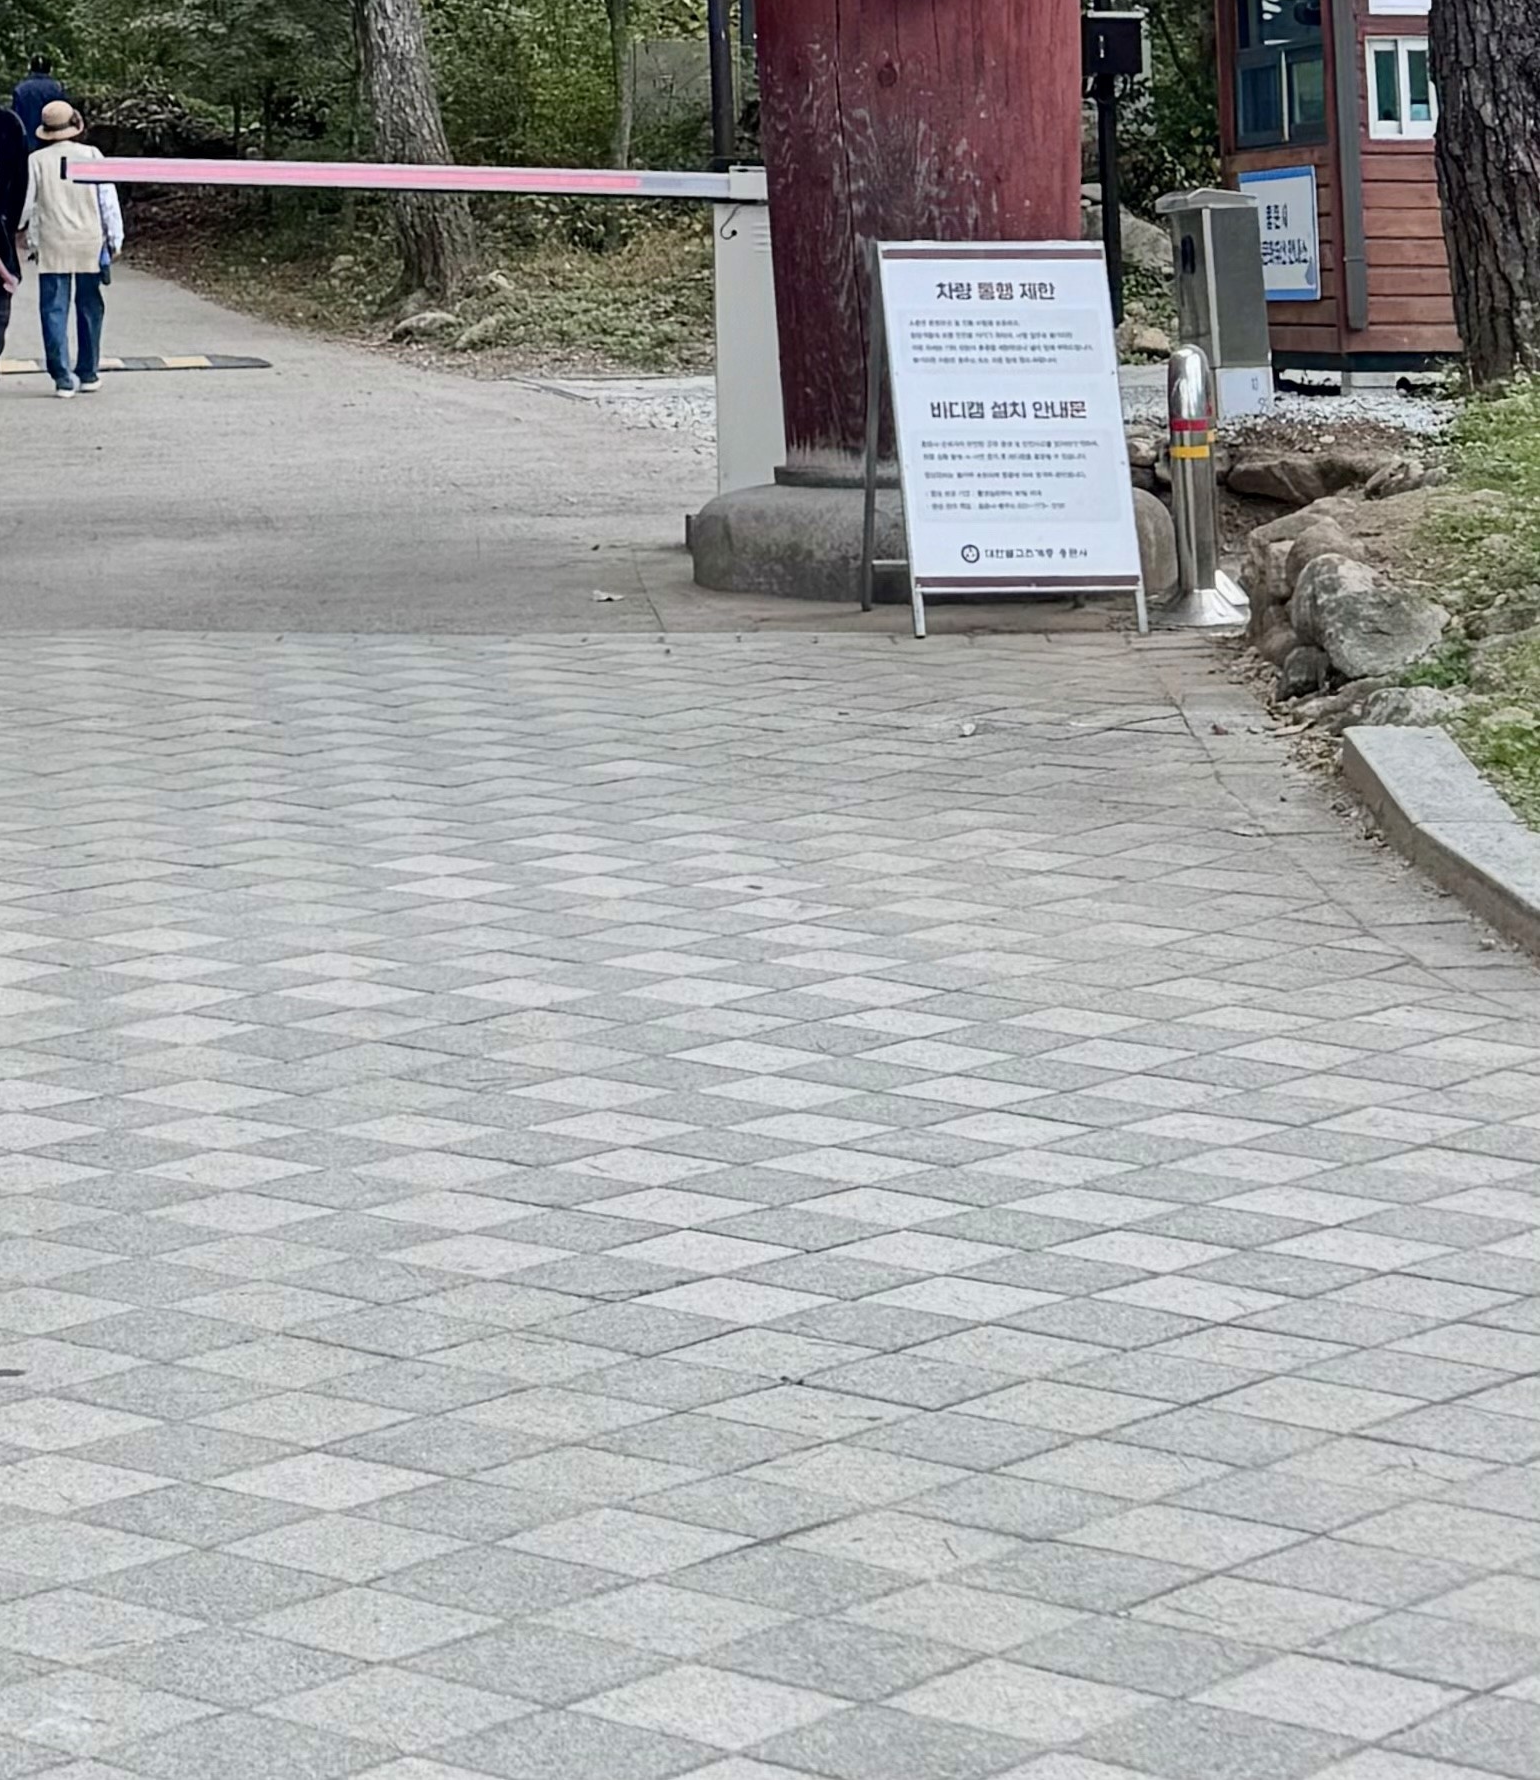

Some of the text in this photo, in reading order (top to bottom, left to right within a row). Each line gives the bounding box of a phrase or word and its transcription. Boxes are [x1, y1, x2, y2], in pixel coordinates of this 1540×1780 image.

[935, 281, 1056, 301] 차량 통행 제한
[930, 400, 1088, 420] 바디캠 설치 안내문
